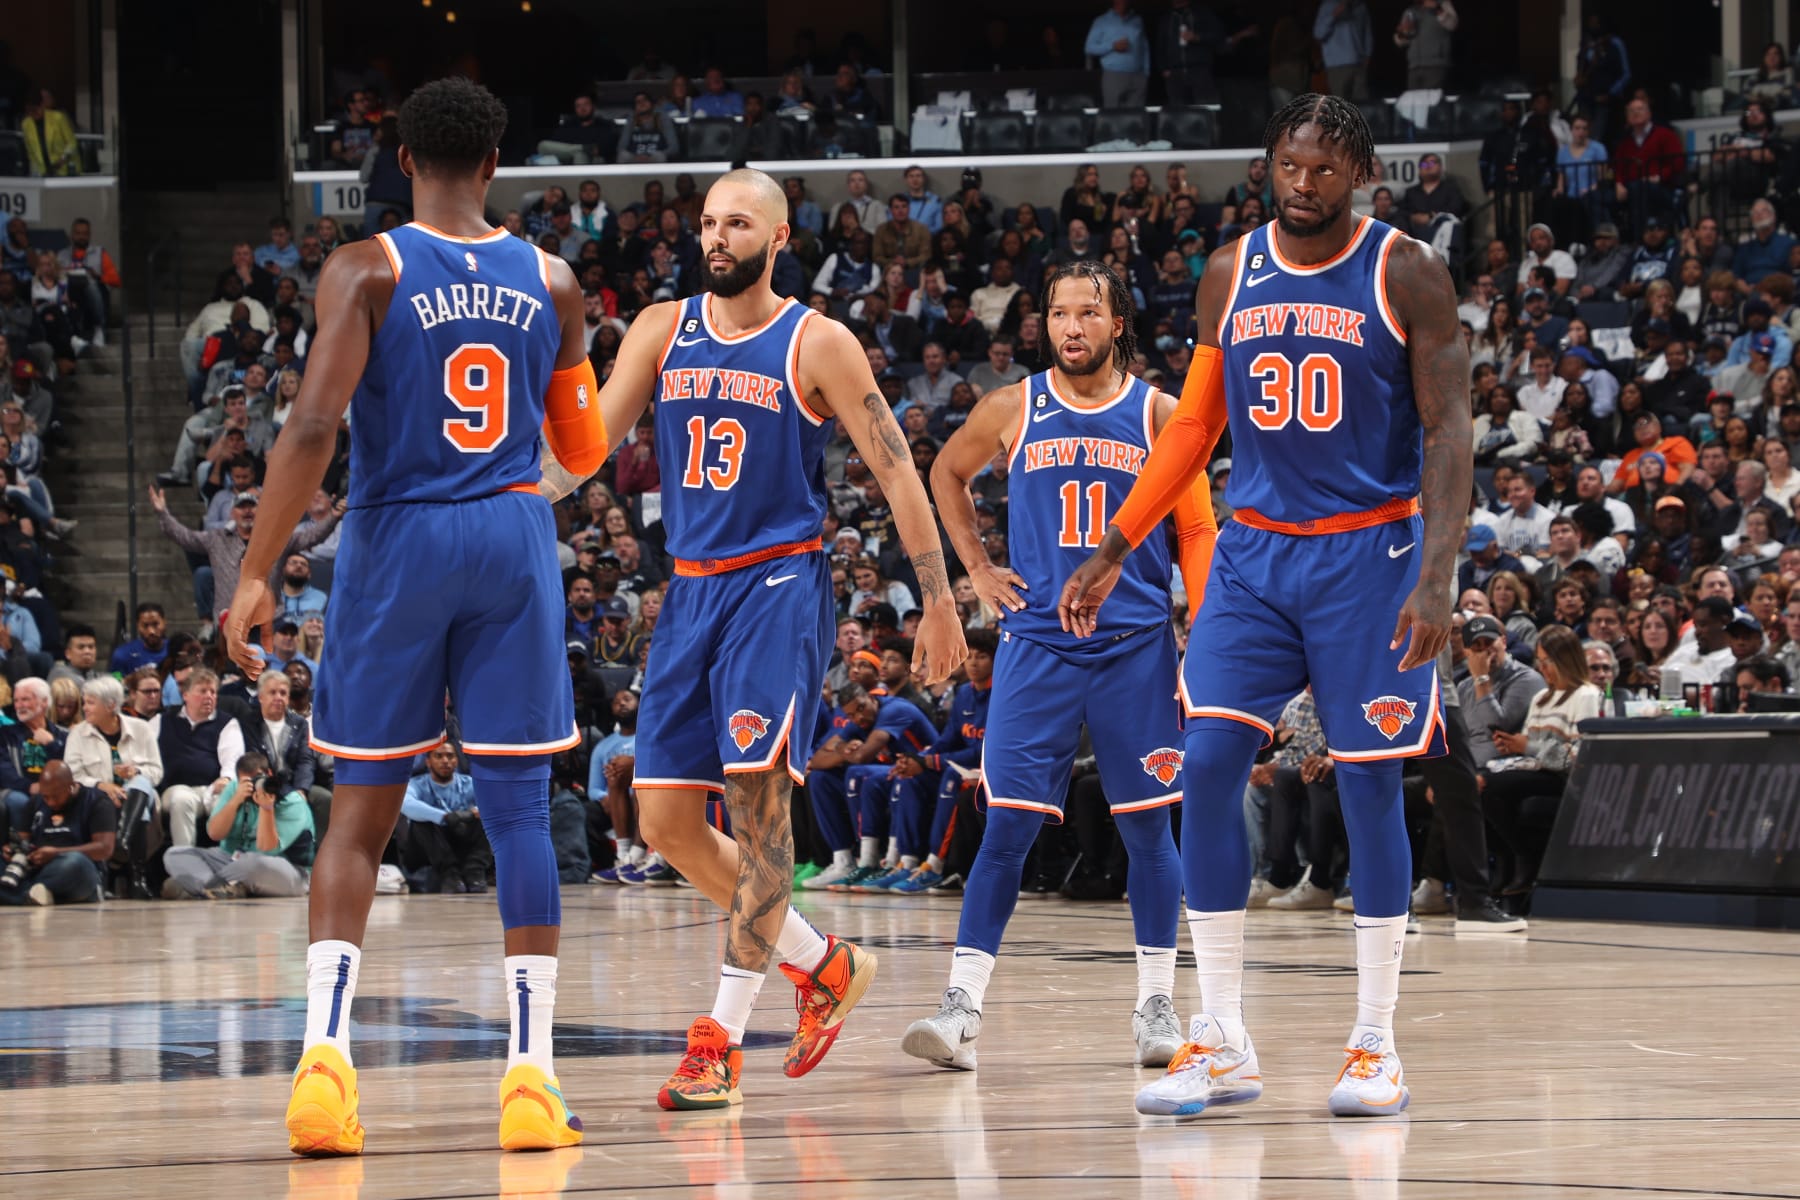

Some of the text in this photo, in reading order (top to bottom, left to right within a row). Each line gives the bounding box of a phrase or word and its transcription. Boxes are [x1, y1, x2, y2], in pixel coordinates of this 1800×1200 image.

[335, 186, 368, 210] 10
[1250, 254, 1264, 269] 6
[410, 283, 543, 331] BARRETT
[684, 319, 698, 332] 6
[1231, 302, 1366, 348] NEW YORK
[443, 343, 510, 453] 9
[661, 367, 783, 413] NEW YORK
[1036, 394, 1047, 408] 6
[1248, 352, 1343, 431] 30
[682, 416, 747, 491] 13
[1024, 437, 1146, 476] NEW YORK
[1058, 480, 1106, 548] 11
[731, 715, 765, 731] KNICKS
[1367, 700, 1413, 720] KNICKS
[1146, 751, 1183, 770] KNICKS
